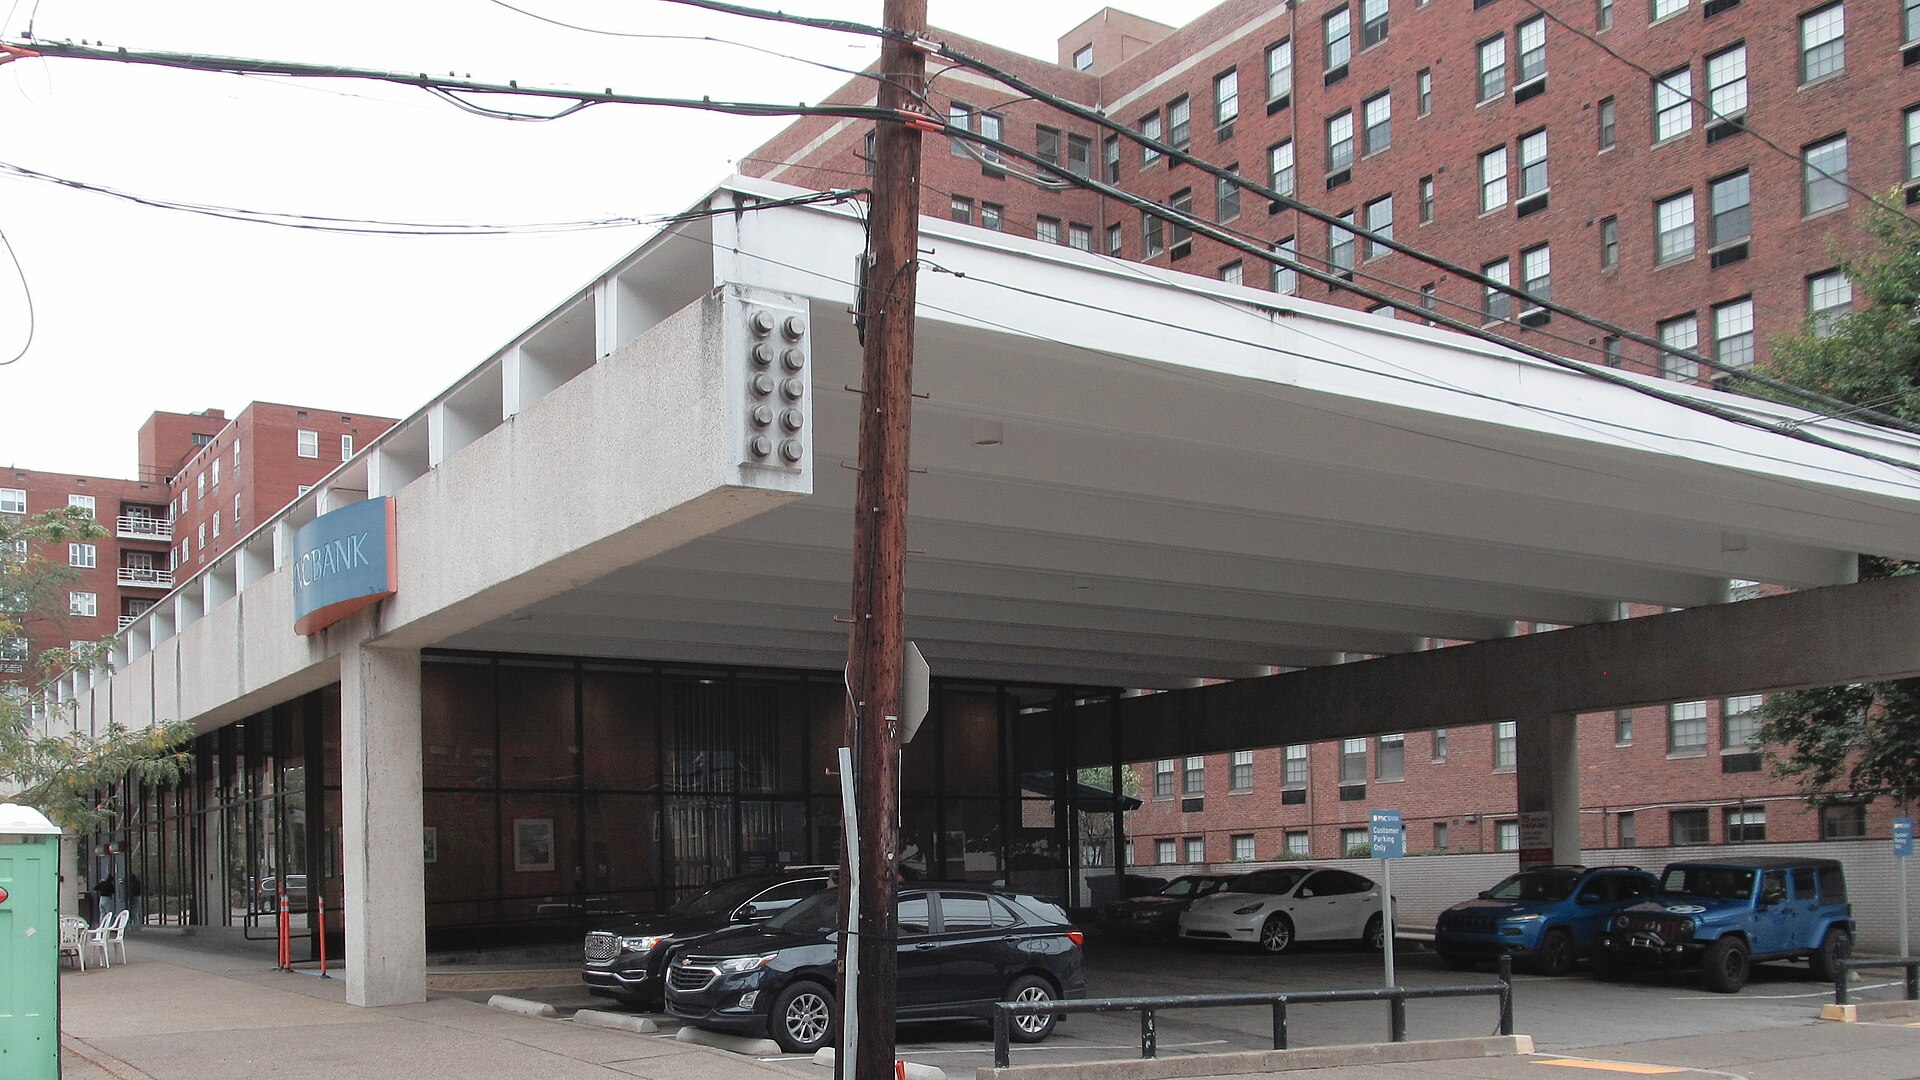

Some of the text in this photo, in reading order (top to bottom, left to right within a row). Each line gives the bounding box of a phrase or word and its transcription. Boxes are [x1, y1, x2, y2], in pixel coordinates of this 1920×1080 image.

[294, 531, 369, 593] NCBANK
[1373, 835, 1395, 844] Parking
[1373, 843, 1387, 853] Only
